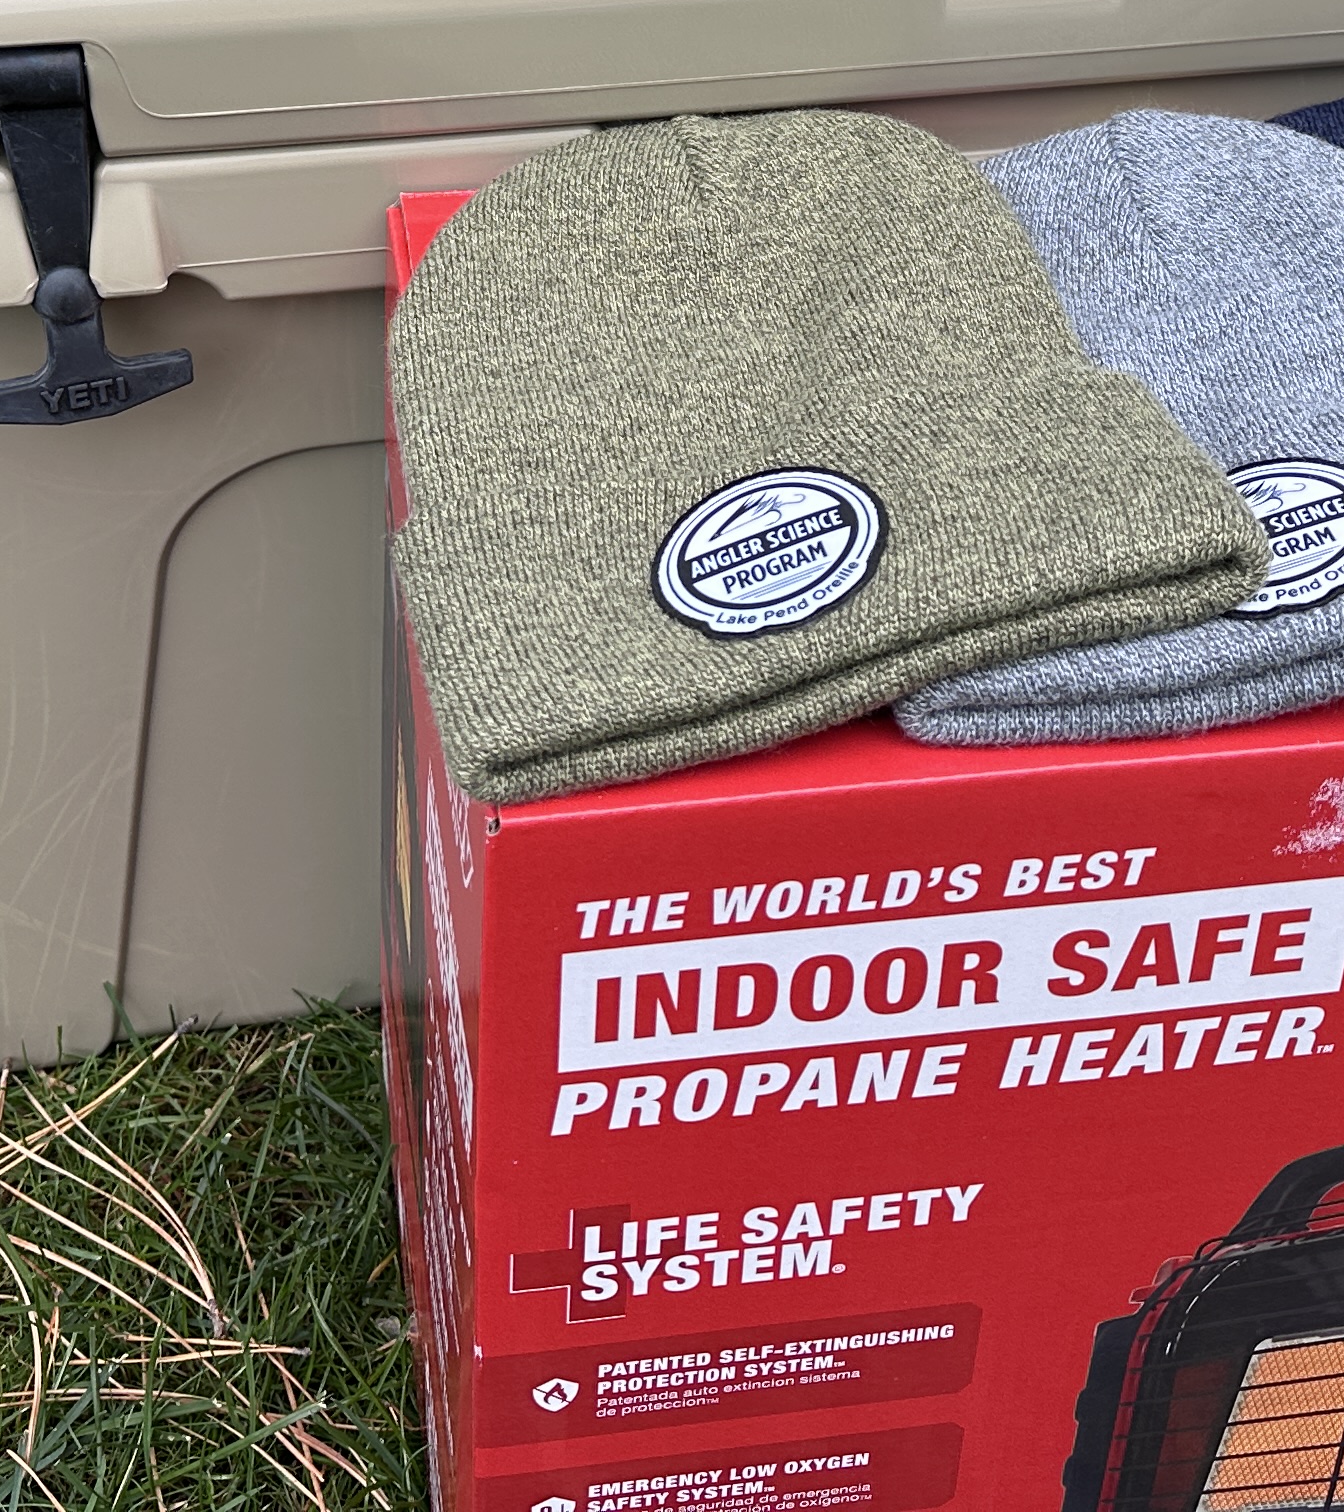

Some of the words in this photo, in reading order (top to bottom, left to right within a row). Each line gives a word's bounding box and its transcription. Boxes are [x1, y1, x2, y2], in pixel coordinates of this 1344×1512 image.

[40, 375, 129, 413] YETI
[691, 537, 765, 579] ANGLER
[769, 509, 843, 550] SCIENCE
[722, 540, 828, 594] PROGRAM
[716, 612, 757, 625] Lake
[764, 598, 809, 621] Pend
[812, 560, 860, 600] Oreille
[1275, 578, 1322, 600] Pend
[575, 891, 688, 940] THE
[712, 862, 984, 922] WORLD'S
[1004, 846, 1156, 897] BEST
[593, 940, 1005, 1044] INDOOR
[1046, 908, 1312, 997] SAFE
[550, 1042, 969, 1136] PROPANE
[1000, 1005, 1325, 1090] HEATER
[583, 1212, 720, 1262] LIFE
[742, 1184, 984, 1243] SAFETY
[581, 1239, 834, 1303] SYSTEM
[598, 1353, 711, 1378] PATENTED
[719, 1324, 954, 1364] SELF-EXTINGUISHING
[597, 1368, 736, 1395] PROTECTION
[597, 1390, 678, 1408] Patentada
[683, 1385, 718, 1398] auto
[724, 1376, 794, 1393] extincion
[800, 1369, 860, 1384] sistema
[596, 1406, 617, 1418] de
[587, 1492, 669, 1512] SAFETY
[588, 1470, 722, 1498] EMERGENCY
[730, 1464, 776, 1482] LOW
[784, 1453, 870, 1474] OXYGEN
[760, 1493, 780, 1505] de
[783, 1484, 871, 1502] emergencia
